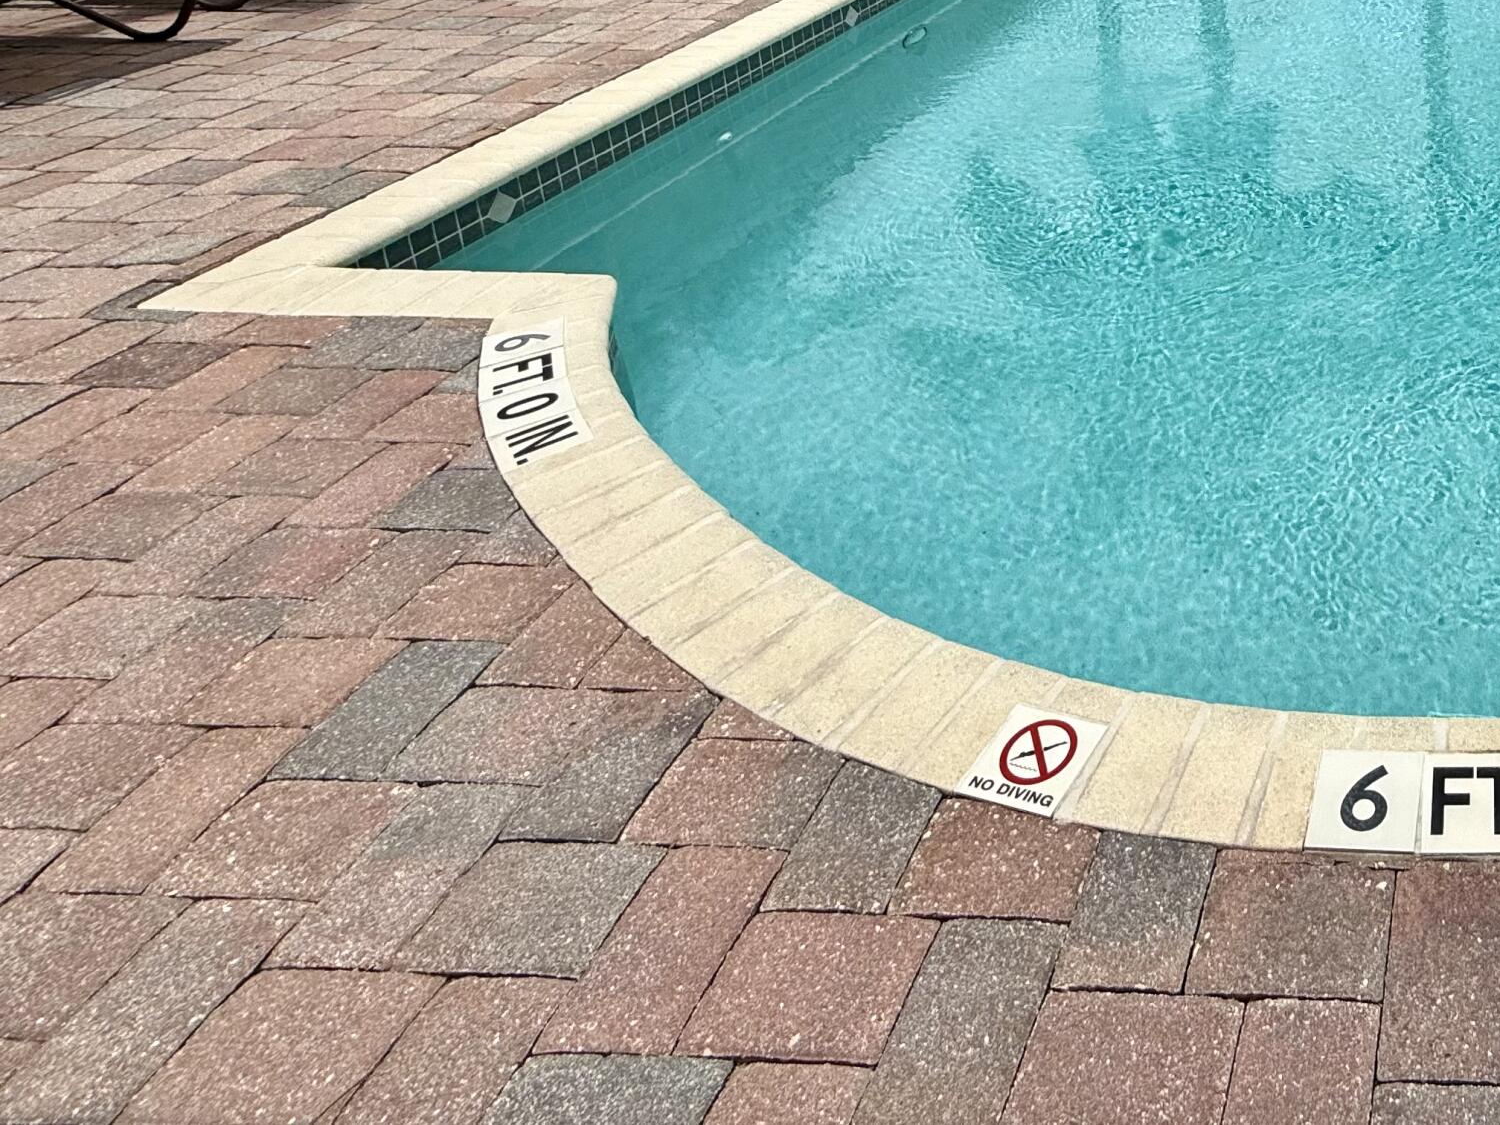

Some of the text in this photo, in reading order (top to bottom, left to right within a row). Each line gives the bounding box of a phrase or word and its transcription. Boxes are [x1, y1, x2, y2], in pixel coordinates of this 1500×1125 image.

[492, 333, 579, 466] 6 FT. 0 IN.
[968, 775, 1054, 808] NO DIVING
[1339, 763, 1389, 833] 6
